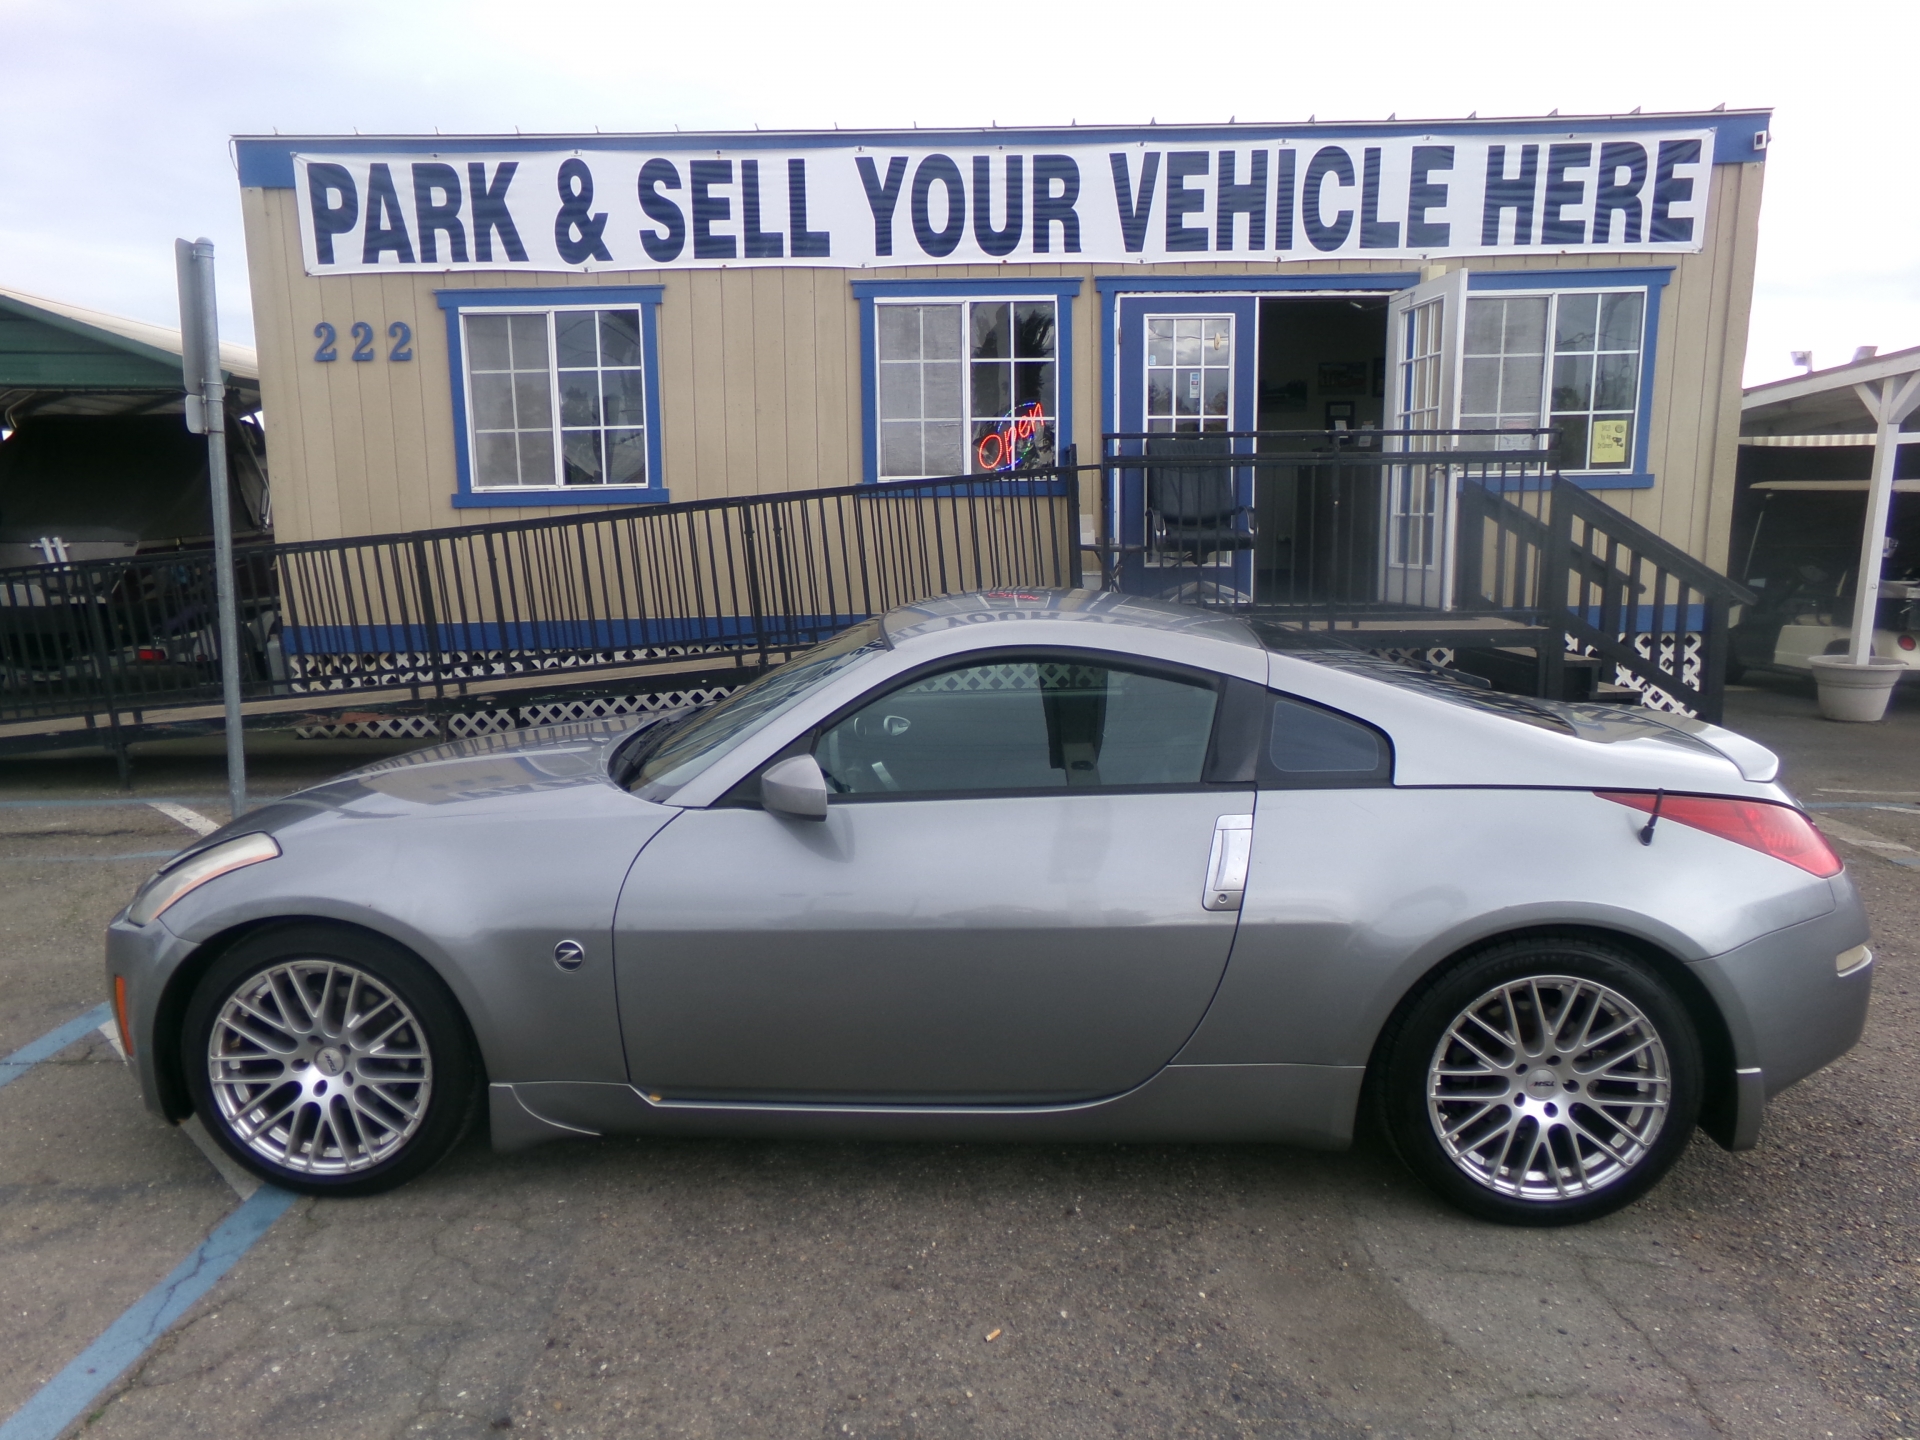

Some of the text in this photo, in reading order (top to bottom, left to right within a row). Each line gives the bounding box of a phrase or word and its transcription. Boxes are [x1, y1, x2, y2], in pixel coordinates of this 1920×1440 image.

[307, 139, 1703, 265] PARK & SELL YOUR VEHICLE HERE
[314, 321, 412, 362] 222
[979, 402, 1044, 469] Open
